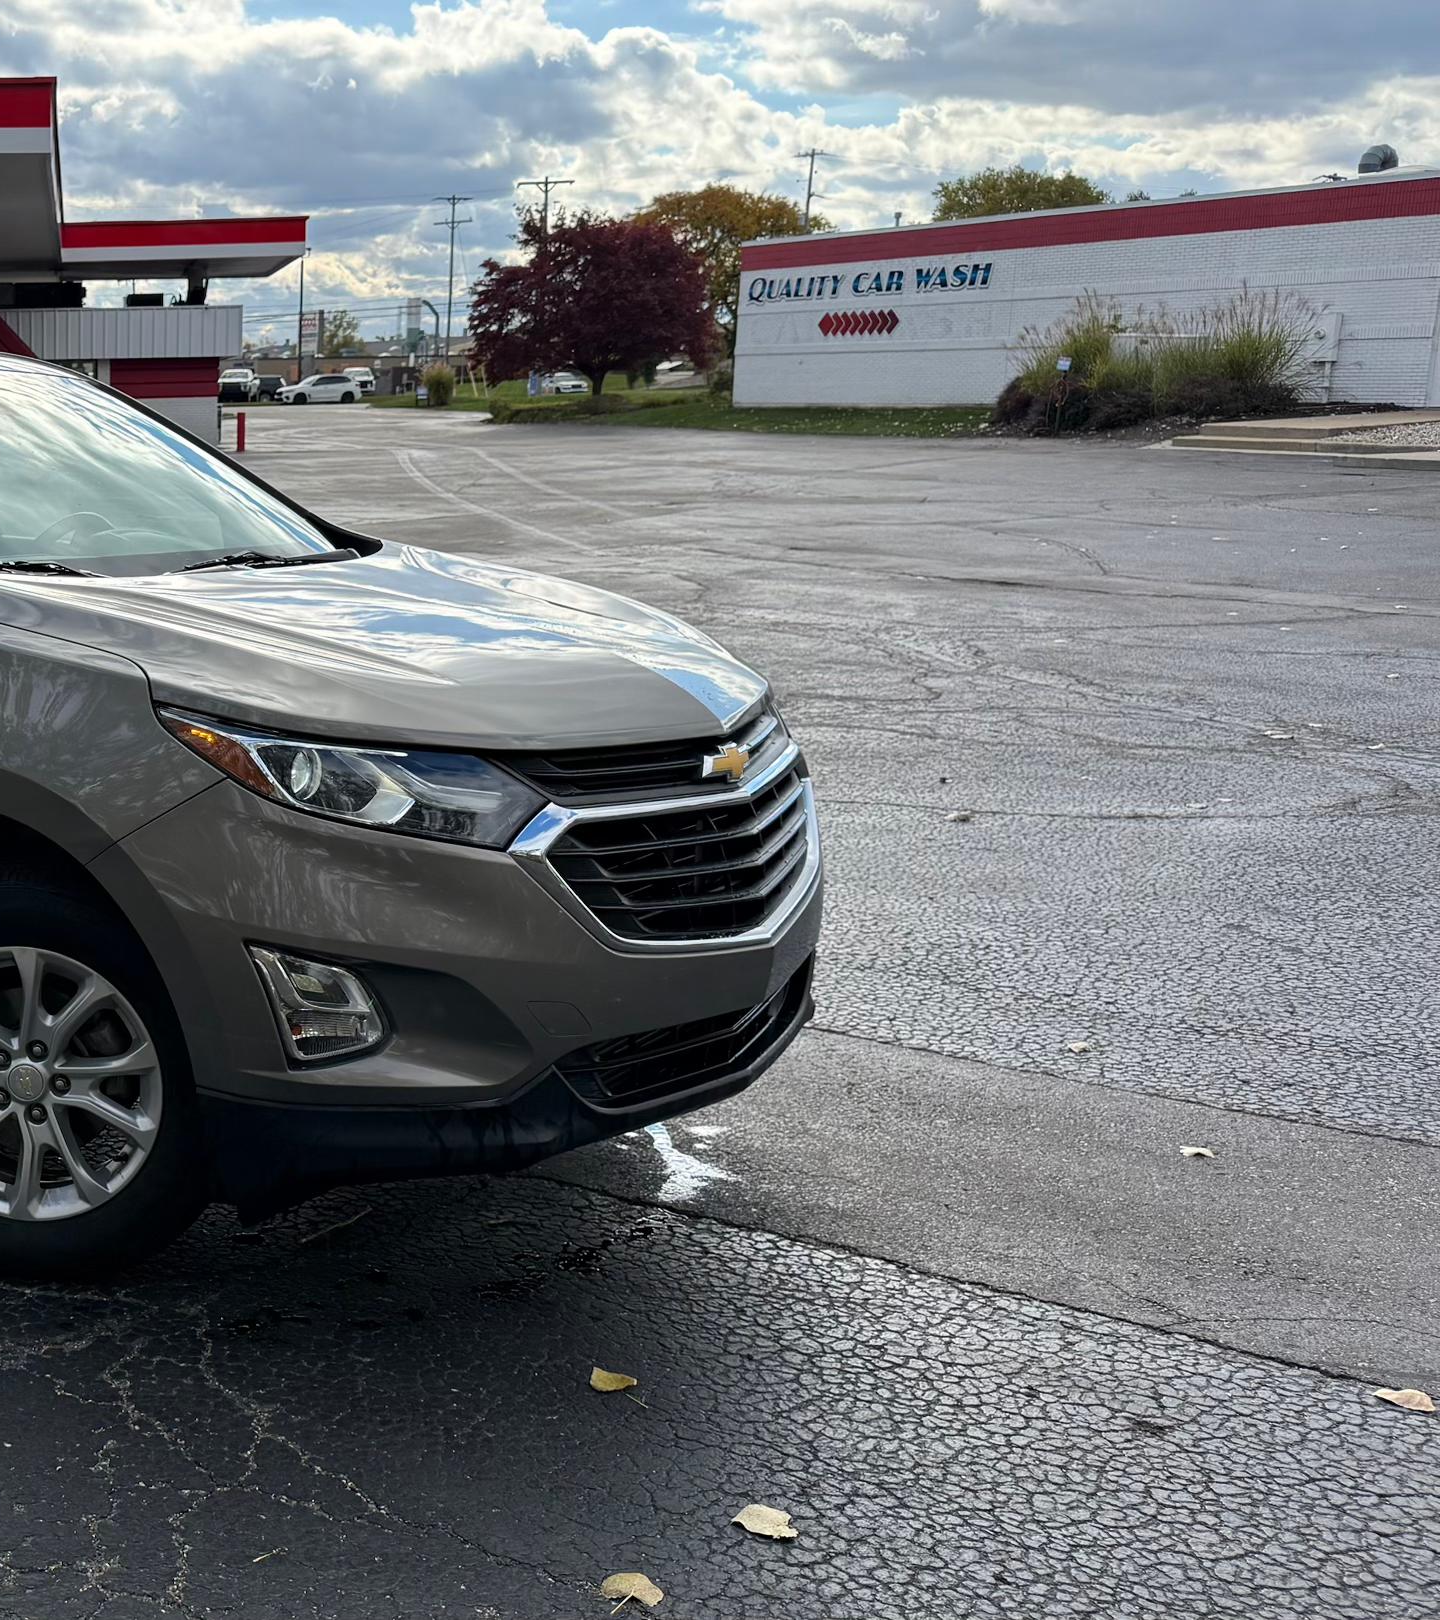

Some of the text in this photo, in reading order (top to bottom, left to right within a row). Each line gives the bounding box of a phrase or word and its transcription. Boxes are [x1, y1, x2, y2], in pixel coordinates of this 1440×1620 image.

[747, 262, 993, 303] QUALITY CAR WASH
